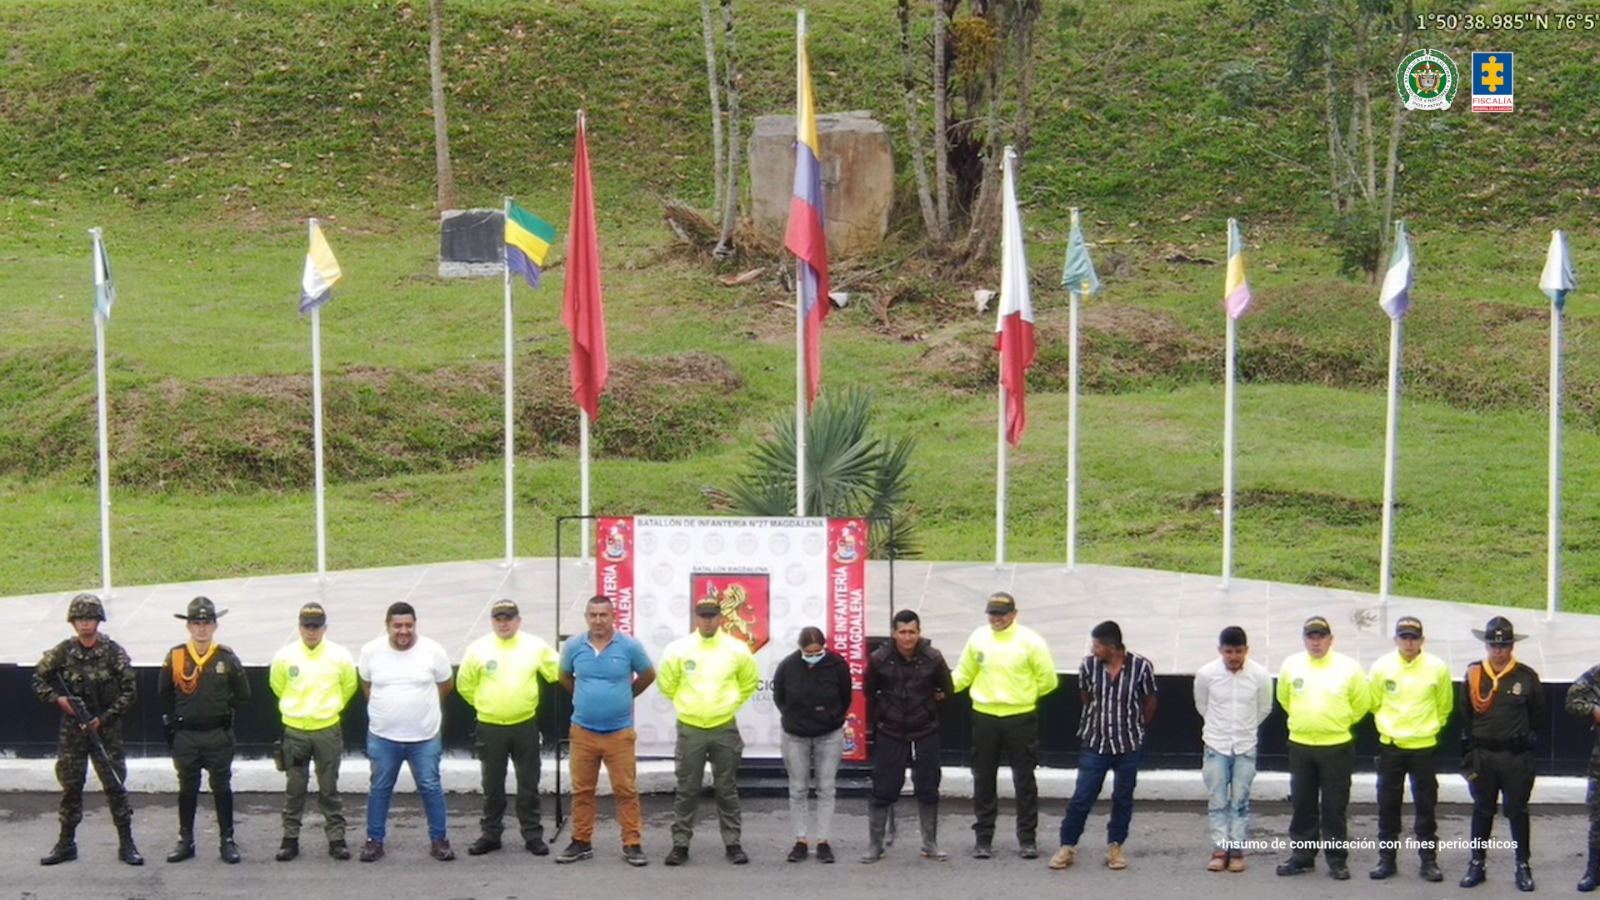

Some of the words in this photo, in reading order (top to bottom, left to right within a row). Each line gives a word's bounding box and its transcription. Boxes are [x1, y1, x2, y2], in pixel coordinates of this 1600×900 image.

[684, 519, 695, 527] DE
[770, 519, 824, 528] MAGDALENA
[619, 587, 632, 633] DALENA
[831, 566, 848, 632] INFANTERÍA
[850, 588, 863, 660] MAGDALENA
[834, 634, 848, 650] DE
[850, 662, 863, 674] 27
